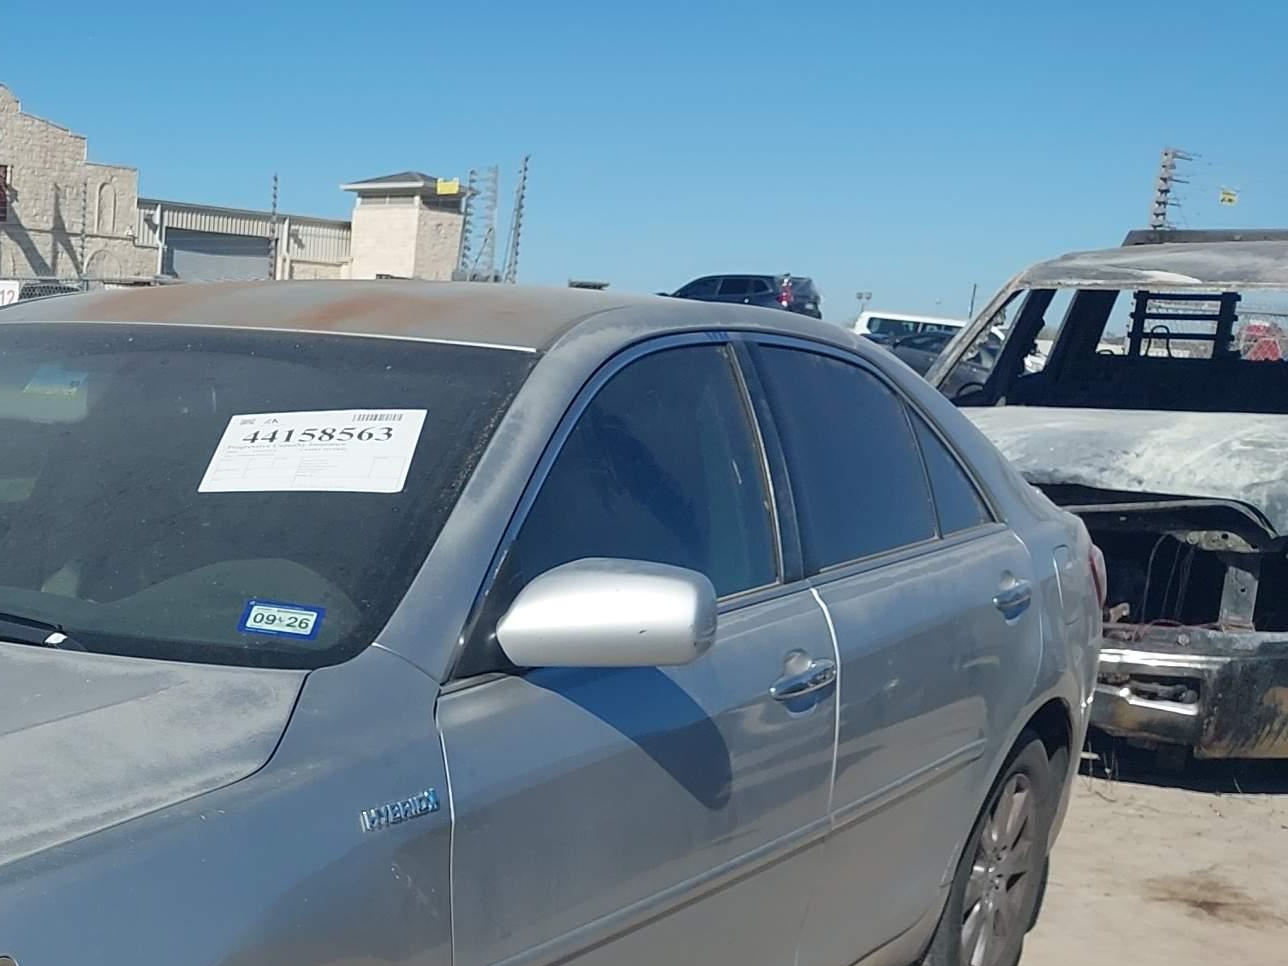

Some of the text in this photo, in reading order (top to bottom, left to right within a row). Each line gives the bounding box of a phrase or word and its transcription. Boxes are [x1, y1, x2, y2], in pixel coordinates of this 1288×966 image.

[0, 289, 15, 305] 12
[242, 427, 393, 444] 44158563
[253, 613, 311, 630] 09 26
